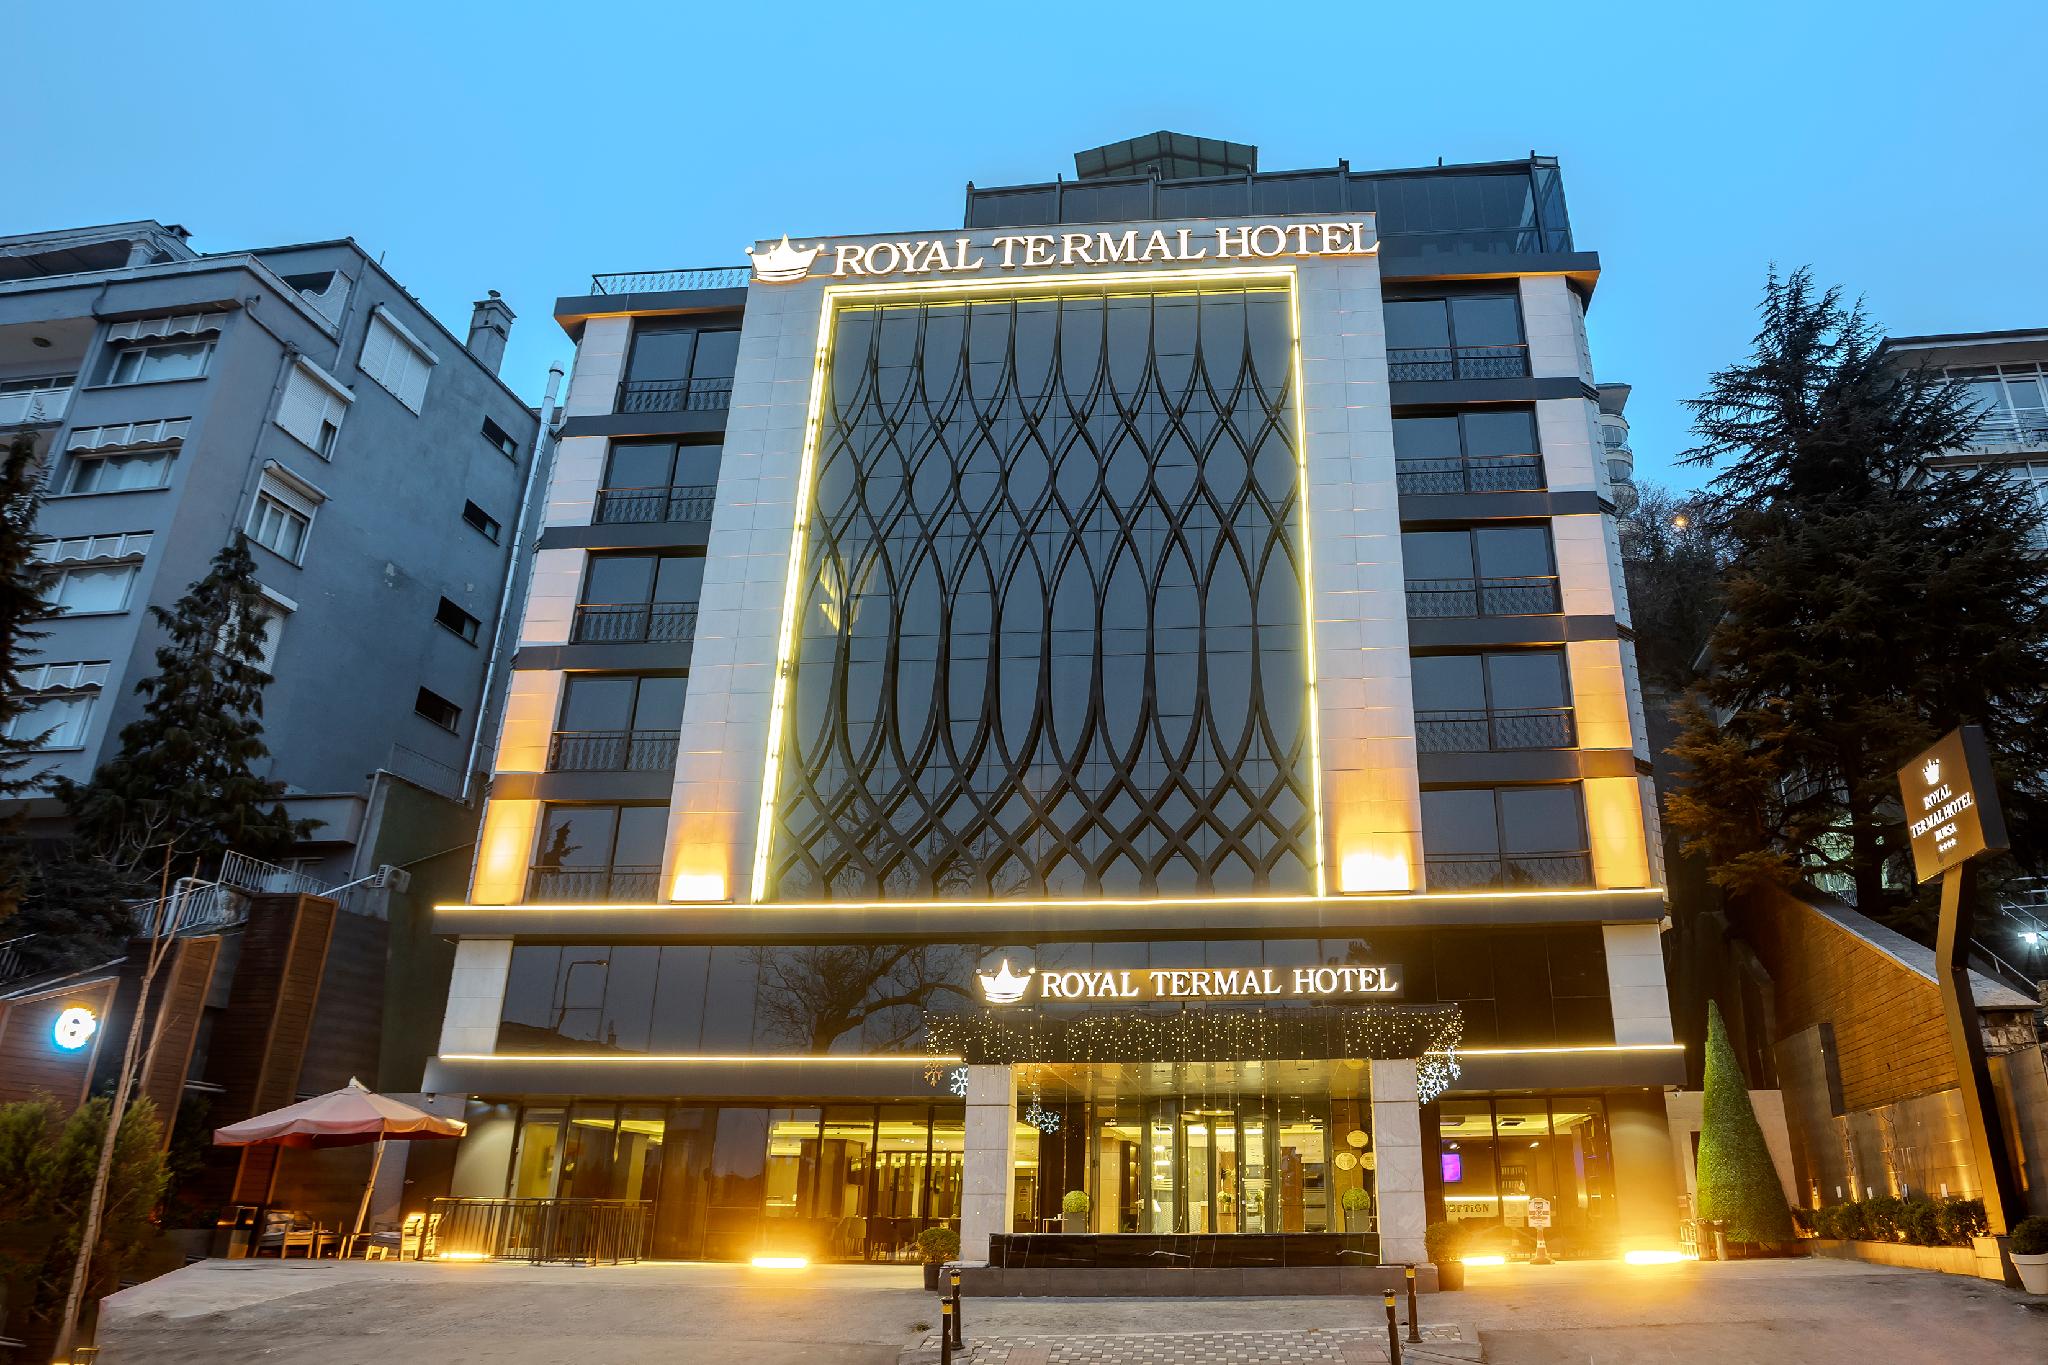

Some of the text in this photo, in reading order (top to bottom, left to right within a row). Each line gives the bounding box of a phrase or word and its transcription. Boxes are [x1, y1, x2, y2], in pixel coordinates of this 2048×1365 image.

[833, 221, 1381, 277] ROYAL TERMAL HOTEL
[1923, 784, 1951, 810] ROYAL
[1040, 967, 1398, 998] ROYAL TERMAL HOTEL
